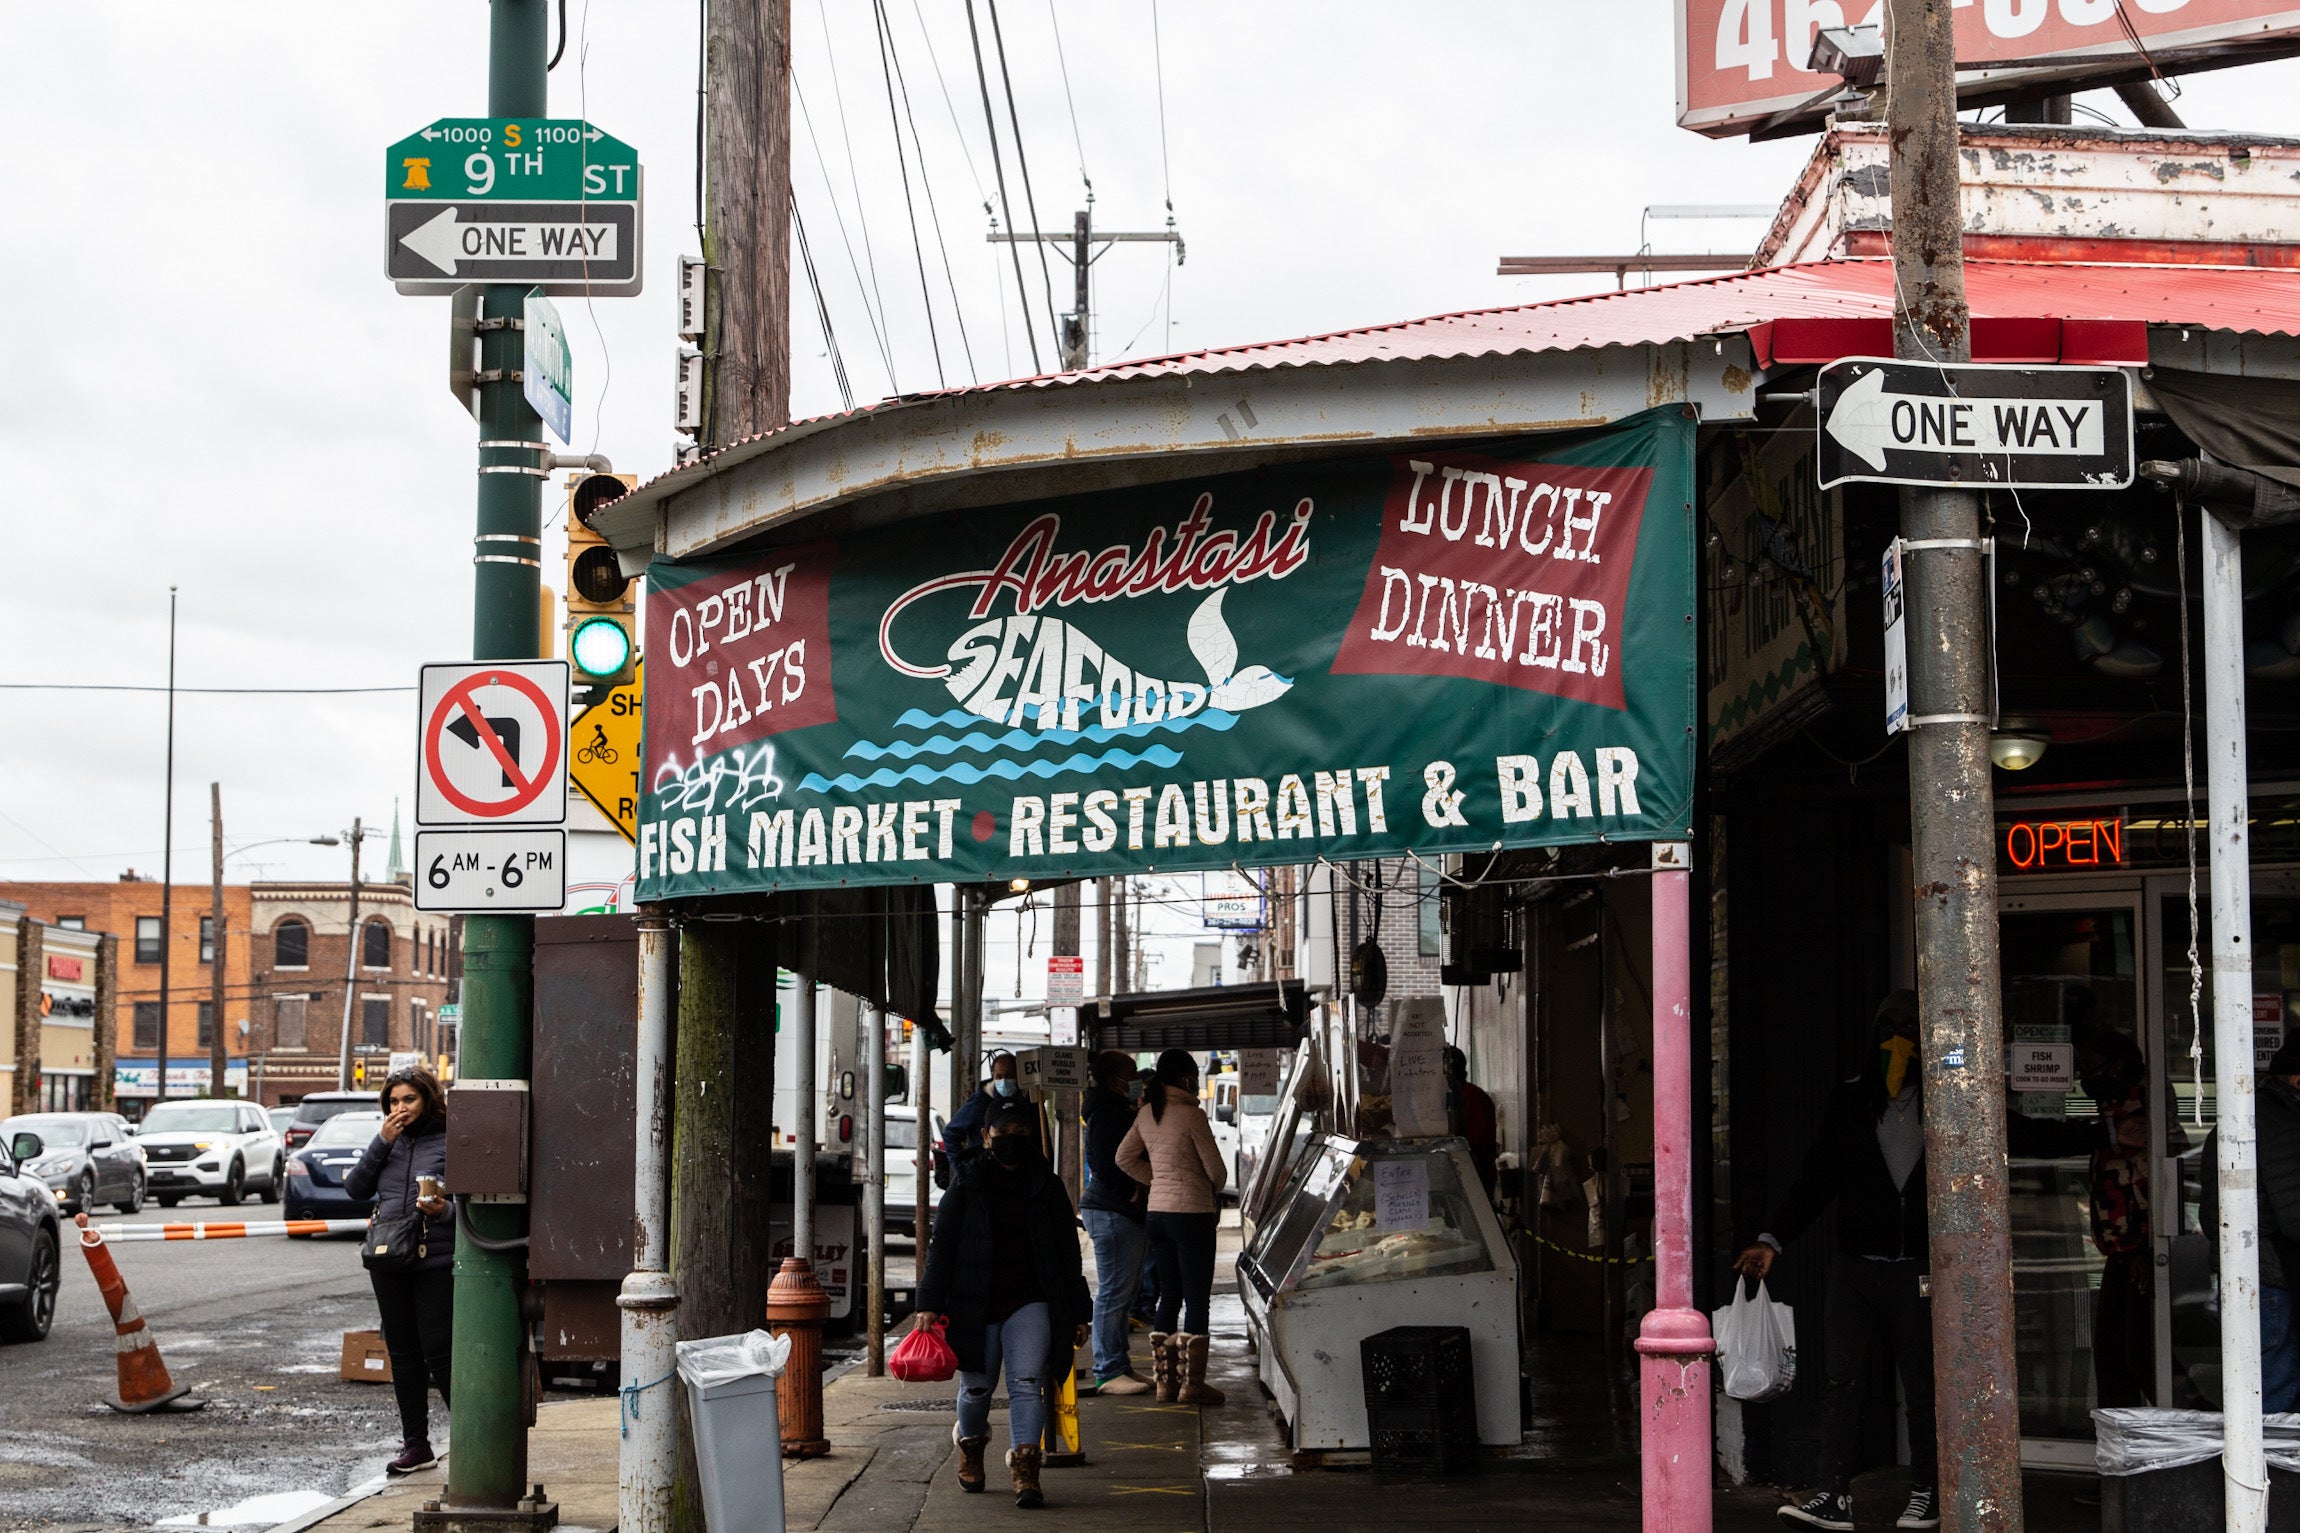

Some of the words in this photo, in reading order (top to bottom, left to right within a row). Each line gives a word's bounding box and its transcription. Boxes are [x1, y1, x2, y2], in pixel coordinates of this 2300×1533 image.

[442, 126, 492, 143] 1000
[504, 123, 521, 147] S
[535, 126, 580, 144] 1100
[584, 165, 631, 194] ST
[462, 227, 527, 256] ONE
[540, 227, 608, 256] WAY
[1891, 399, 1976, 447] ONE
[1994, 404, 2090, 449] WAY
[1399, 458, 1613, 564] LUNCH
[964, 490, 1315, 619] Anastasi
[669, 562, 796, 668] OPEN
[1370, 565, 1610, 678] DINNER
[944, 614, 1212, 731] SEAFOOD
[610, 693, 642, 716] SH
[691, 639, 806, 747] DAYS
[640, 813, 727, 880] FISH
[747, 798, 962, 869] MARKET
[1008, 765, 1391, 858] RESTAURANT
[1422, 760, 1469, 829] &
[1496, 746, 1642, 825] BAR
[2007, 819, 2121, 867] OPEN
[1217, 902, 1247, 911] PROS
[2254, 1010, 2268, 1018] LERT
[2031, 1051, 2053, 1061] FISH
[2255, 1036, 2280, 1048] UIRED
[1024, 1060, 1041, 1075] EXI
[1400, 1055, 1426, 1067] LIVE
[2024, 1064, 2061, 1073] SHRIMP
